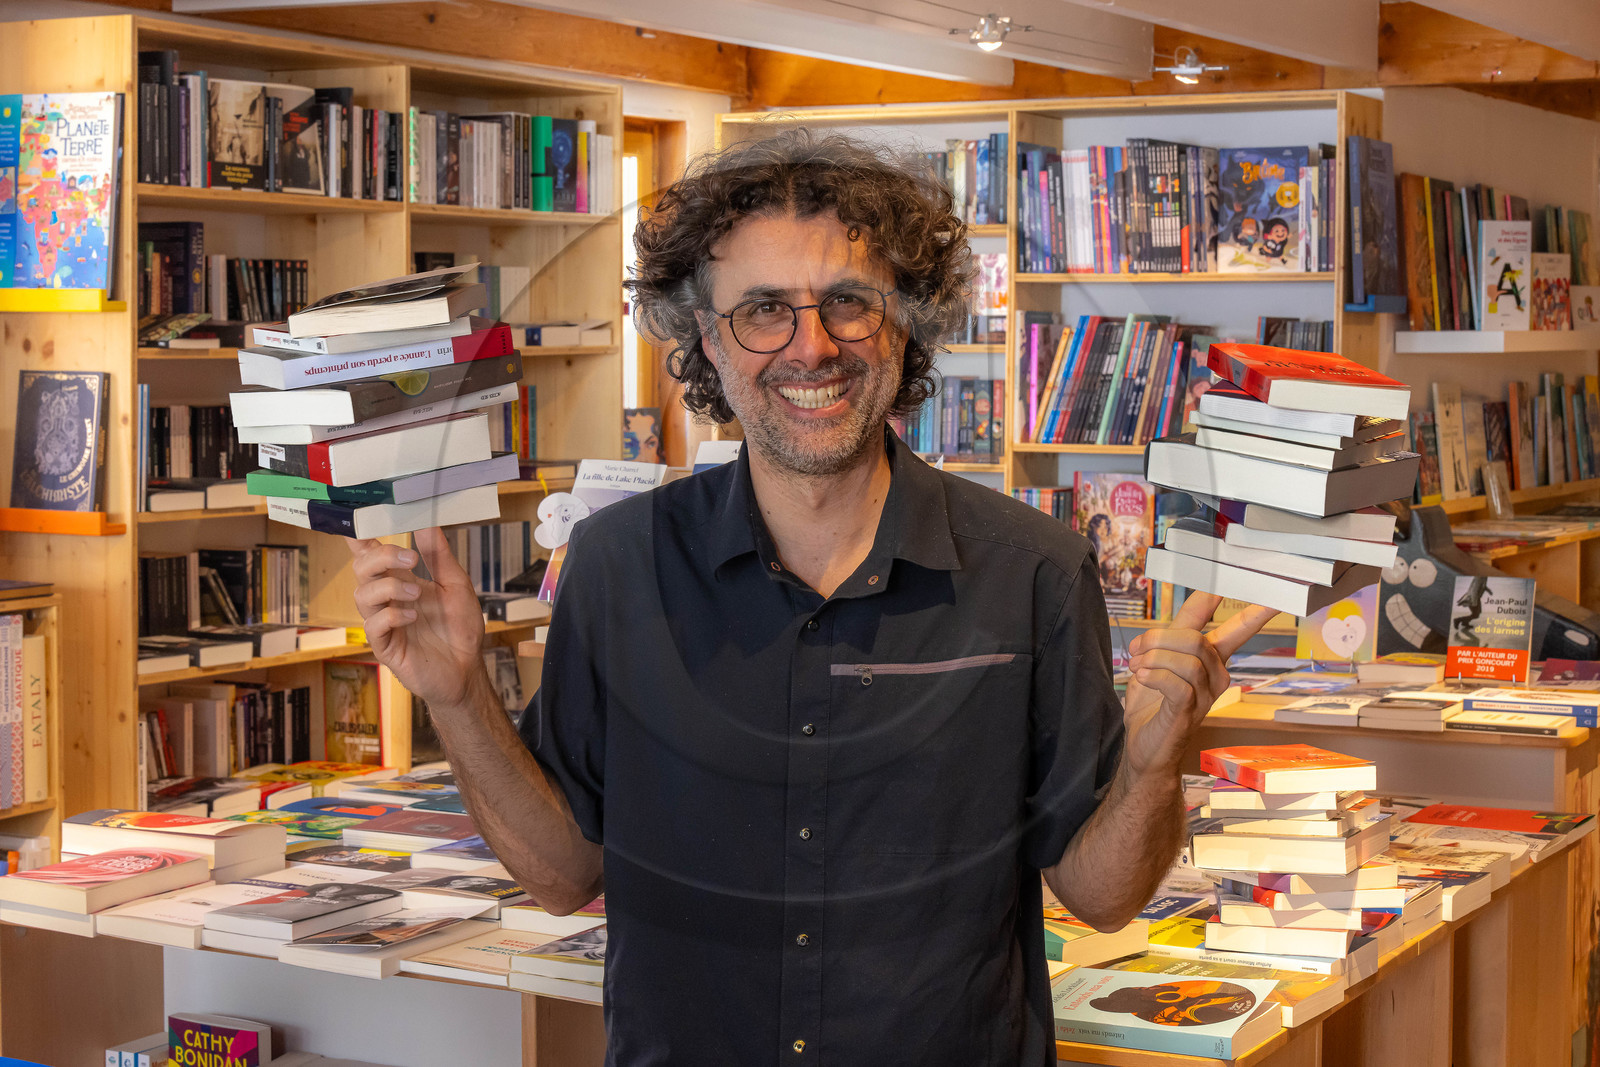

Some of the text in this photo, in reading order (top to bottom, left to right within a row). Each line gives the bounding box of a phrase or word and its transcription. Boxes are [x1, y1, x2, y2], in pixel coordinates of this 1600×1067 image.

[60, 138, 102, 156] TERRE
[366, 355, 392, 368] perdu
[400, 350, 431, 362] L'année
[304, 361, 350, 377] printemps
[350, 360, 367, 369] son
[84, 418, 93, 447] SECRET
[592, 473, 606, 481] fille
[606, 474, 614, 482] de
[615, 474, 632, 483] Lake
[633, 476, 656, 485] Placid
[1484, 597, 1528, 606] Jean-Paul
[1497, 606, 1526, 615] Dubois
[1486, 618, 1526, 627] L'origine
[1474, 625, 1525, 636] des larmes
[1472, 651, 1505, 659] L'AUTEUR
[1507, 652, 1517, 660] DU
[1475, 658, 1515, 667] GONCOURT
[30, 674, 42, 748] EATALY
[1063, 976, 1114, 1011] Entends ma voix
[1060, 1026, 1076, 1034] Zelda
[1078, 1028, 1090, 1036] voix
[1100, 1030, 1125, 1040] Entends
[184, 1029, 234, 1053] CATHY
[175, 1046, 247, 1067] BONIDAN
